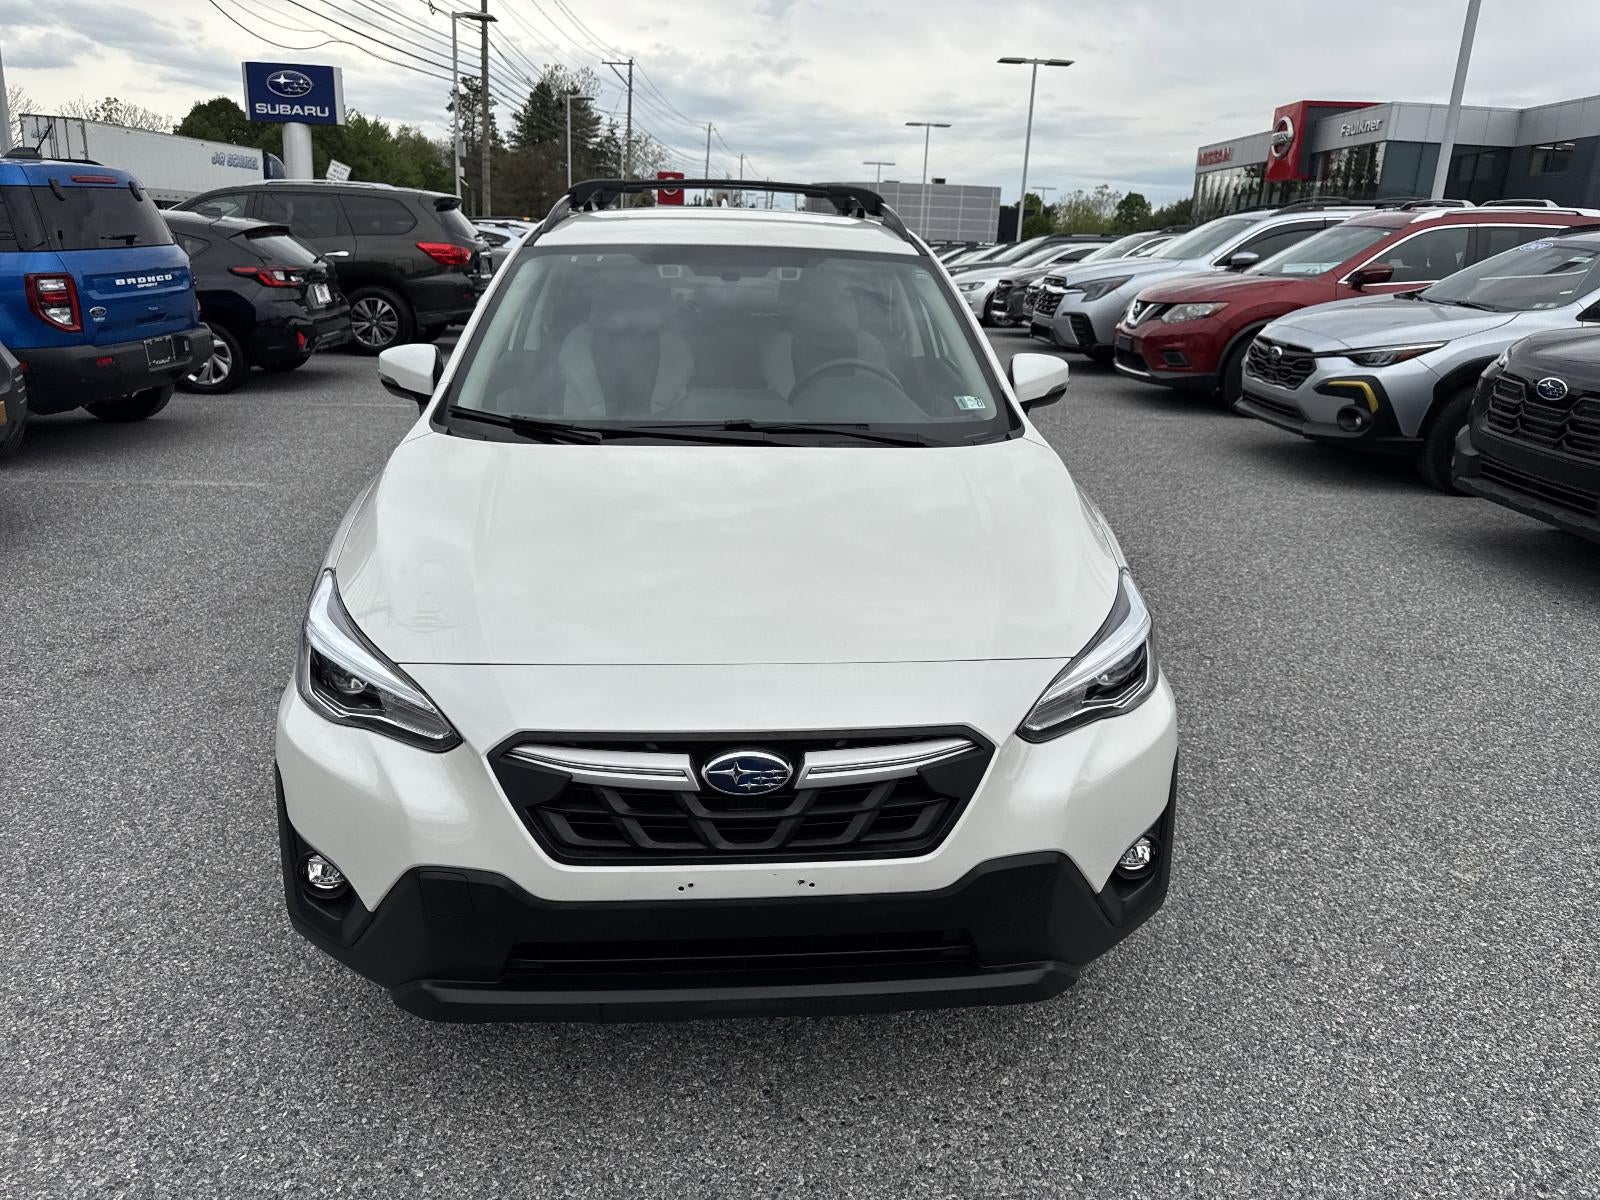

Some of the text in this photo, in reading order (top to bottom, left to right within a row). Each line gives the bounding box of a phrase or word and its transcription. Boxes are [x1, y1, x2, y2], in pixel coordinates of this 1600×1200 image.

[255, 102, 330, 118] SUBARU
[1340, 119, 1382, 137] Faulkner
[1199, 146, 1233, 166] NISSAN
[115, 273, 173, 286] BRONCO
